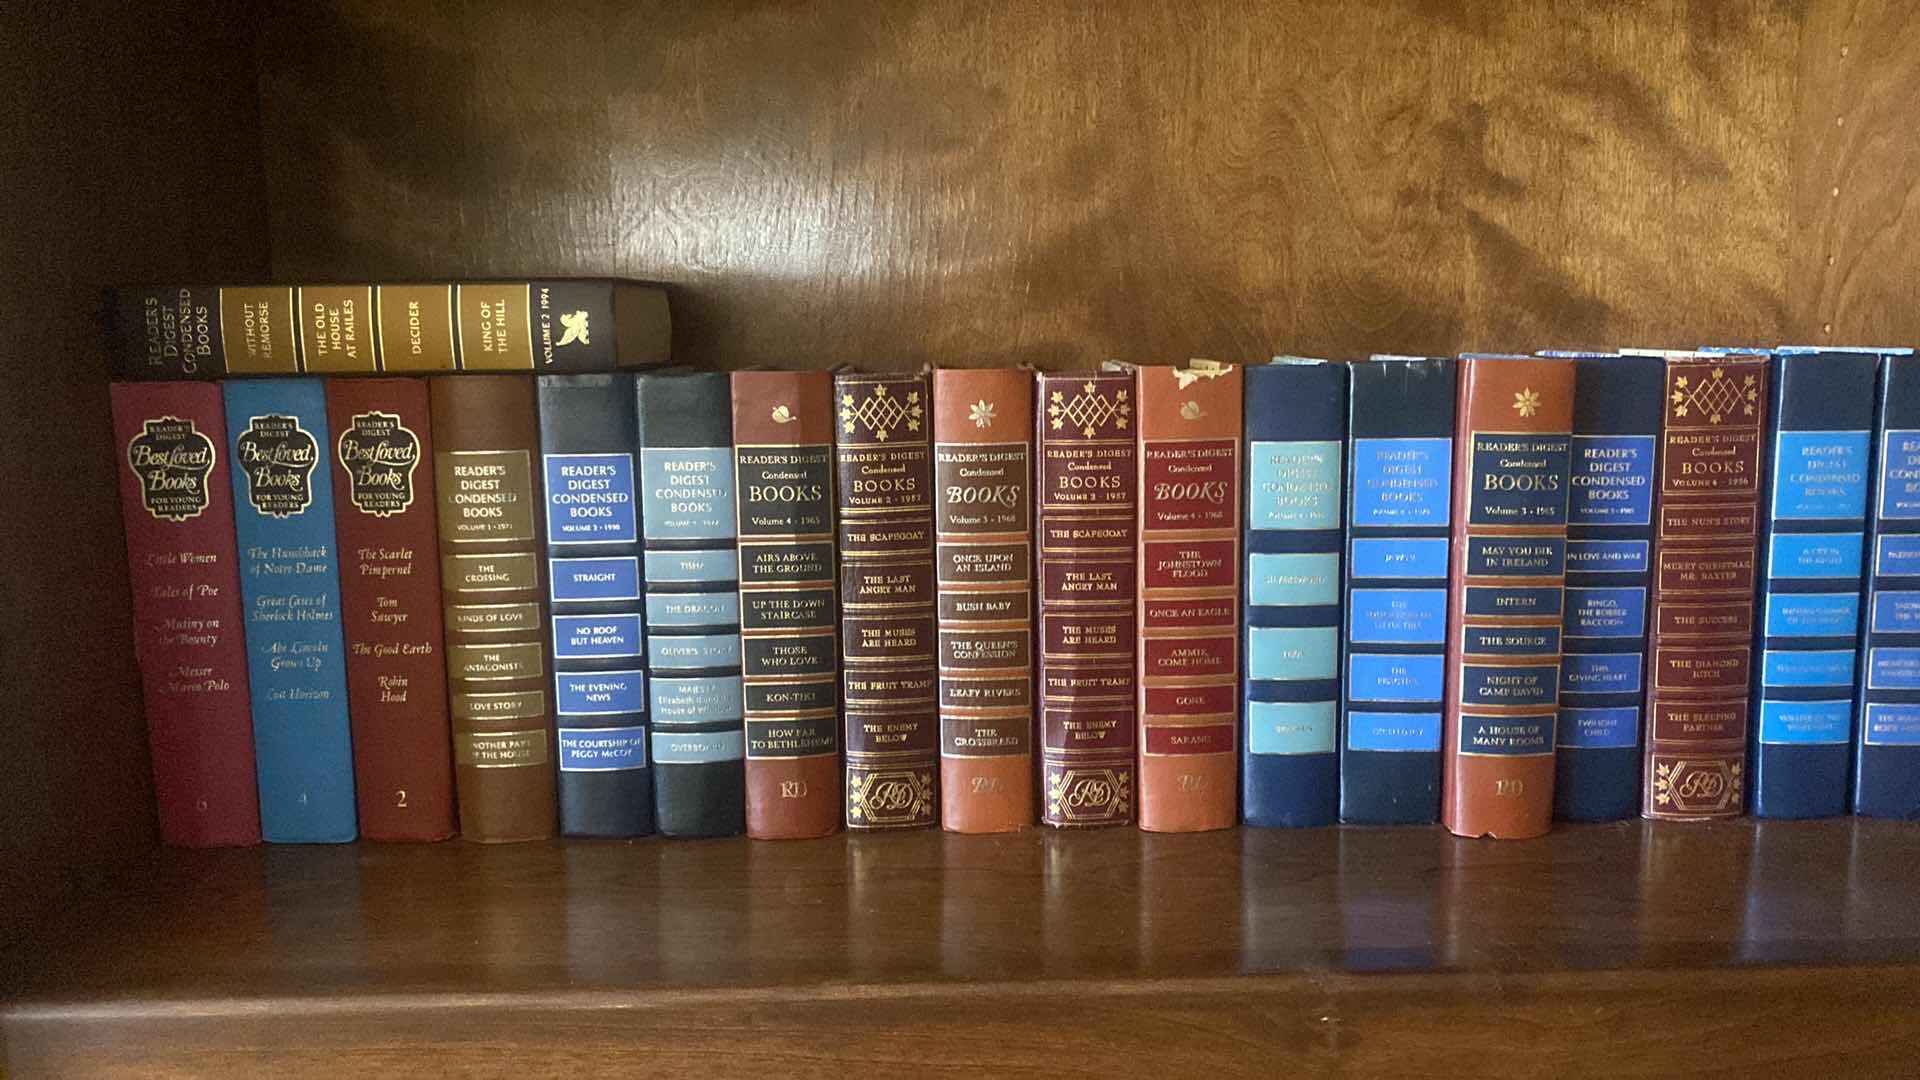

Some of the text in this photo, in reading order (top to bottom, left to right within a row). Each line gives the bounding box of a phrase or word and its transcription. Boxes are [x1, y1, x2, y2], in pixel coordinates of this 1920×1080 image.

[180, 288, 197, 373] CONDENSED
[197, 306, 211, 356] BOOKS
[243, 303, 256, 357] WITHOUT
[258, 301, 272, 359] REMORSE
[315, 303, 328, 355] THE OLD
[330, 309, 341, 350] HOUSE
[343, 299, 357, 359] AT RAILES
[408, 301, 422, 355] DECIDER
[480, 302, 493, 352] KING OF
[496, 299, 508, 354] THE HILL
[541, 288, 552, 364] VOLUME 2 1994
[164, 306, 177, 357] DIGEST
[362, 428, 391, 436] DIGEST
[1669, 435, 1720, 444] READER'S
[890, 452, 925, 460] DIGEST
[1047, 449, 1131, 458] READER'S DIGEST
[1584, 449, 1638, 459] READER'S
[740, 456, 788, 464] READER'S
[455, 466, 506, 476] READER'S
[561, 466, 616, 476] READER'S
[862, 465, 906, 474] Condensed
[1067, 462, 1112, 472] Condensed
[1589, 462, 1632, 472] DIGEST
[1682, 460, 1745, 474] BOOKS
[149, 469, 200, 494] Books
[256, 466, 303, 491] Books
[357, 466, 405, 491] Books
[1059, 476, 1121, 489] BOOKS
[1484, 474, 1559, 491] BOOKS
[1572, 476, 1645, 486] CONDENSED
[461, 480, 500, 490] DIGEST
[568, 480, 611, 490] DIGEST
[853, 478, 916, 493] BOOKS
[358, 492, 405, 500] FOR YOUNG
[750, 485, 822, 502] BOOKS
[946, 485, 1021, 508] BOOKS
[1154, 481, 1228, 504] BOOKS
[1588, 490, 1629, 500] BOOKS
[151, 496, 200, 504] FOR YOUNG
[256, 494, 304, 502] FOR YOUNG
[552, 493, 628, 504] CONDENSED
[158, 504, 197, 512] READERS
[463, 507, 502, 518] BOOKS
[570, 507, 613, 517] BOOKS
[671, 503, 712, 513] BOOKS
[848, 532, 925, 542] THE SCAPEGOAT
[1050, 529, 1128, 539] THE SCAPEGOAT
[358, 547, 413, 560] The Scarlet
[756, 553, 817, 562] AIRS ABOVE
[1179, 551, 1201, 559] THE
[952, 554, 1014, 564] ONCE UPON
[1486, 558, 1549, 567] IN IRELAND
[478, 565, 495, 573] THE
[752, 564, 774, 573] THE
[955, 563, 1012, 572] AN ISLAND
[1158, 559, 1222, 571] JOHNSTOWN
[359, 562, 412, 579] Pimpernel
[1172, 569, 1208, 578] FLOOD
[465, 573, 510, 582] CROSSING
[573, 574, 616, 582] STRAIGHT
[863, 575, 911, 584] THE LAST
[1066, 572, 1112, 581] THE LAST
[859, 585, 916, 594] ANGRY MAN
[1061, 582, 1117, 591] ANGRY MAN
[377, 596, 398, 607] Tom
[752, 599, 825, 609] UP THE DOWN
[956, 602, 1011, 611] BUSH BABY
[1496, 598, 1536, 606] INTERN
[371, 610, 409, 624] Sawyer
[1150, 609, 1179, 618] ONCE
[1181, 609, 1195, 617] AN
[1578, 609, 1593, 617] THE
[576, 626, 617, 635] NO ROOF
[1062, 626, 1082, 634] THE
[571, 637, 624, 646] BUT HEAVEN
[862, 639, 880, 648] ARE
[374, 642, 400, 658] Good
[402, 641, 433, 656] Earth
[773, 646, 807, 655] THOSE
[484, 654, 500, 662] THE
[762, 656, 818, 666] WHO LOVE
[1669, 659, 1740, 668] THE DIAMOND
[378, 675, 408, 688] Robin
[1486, 676, 1538, 685] NIGHT OF
[569, 683, 627, 692] THE EVENING
[381, 690, 407, 702] Hood
[586, 694, 610, 702] NEWS
[864, 724, 882, 732] THE
[975, 729, 997, 737] THE
[875, 734, 907, 743] BELOW
[1473, 737, 1505, 745] MANY
[397, 790, 408, 808] 2
